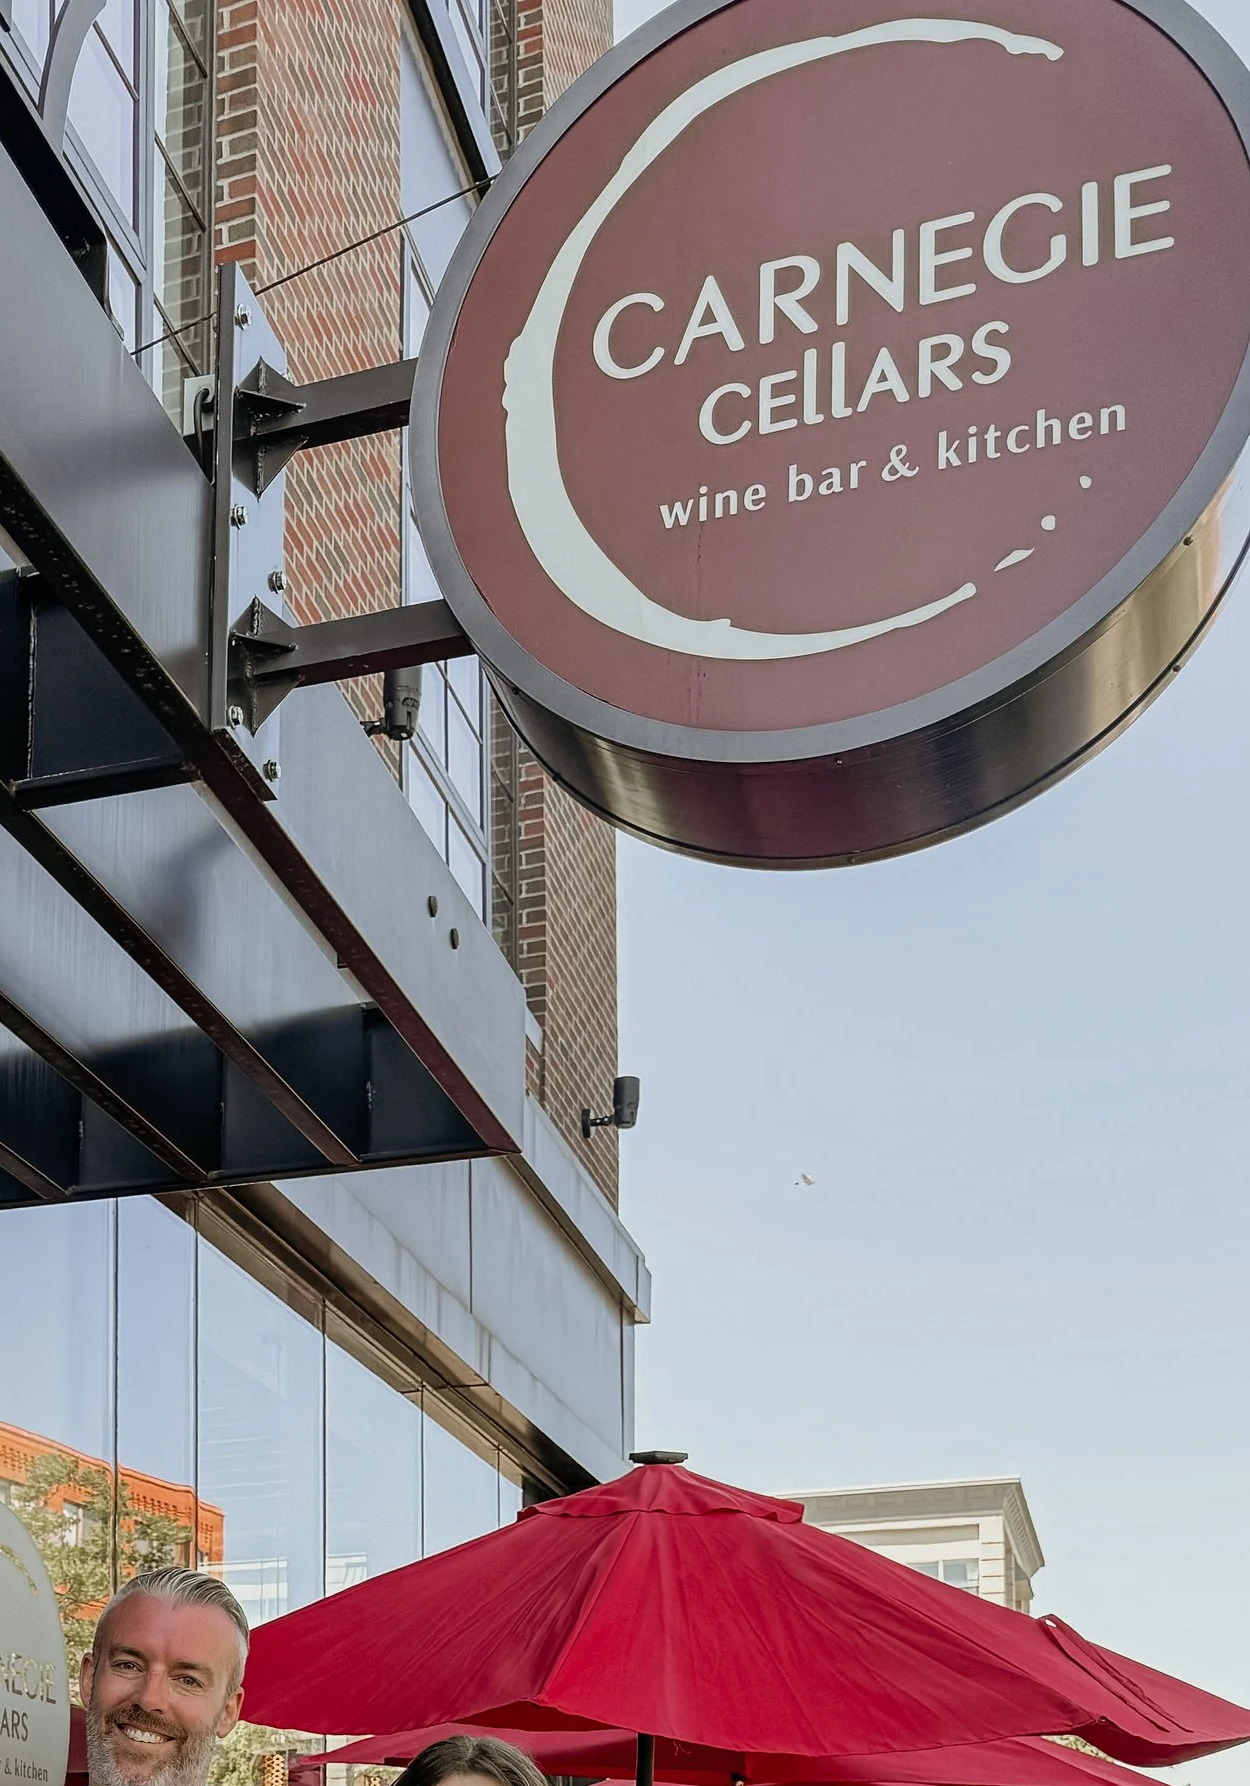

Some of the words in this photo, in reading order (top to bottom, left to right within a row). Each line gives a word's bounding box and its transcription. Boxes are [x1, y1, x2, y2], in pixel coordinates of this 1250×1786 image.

[592, 164, 1175, 380] CARNEGIE
[659, 485, 766, 529] wine
[788, 459, 867, 503] bar
[881, 444, 920, 482] &
[937, 402, 1126, 470] kitchen
[4, 1758, 13, 1776] &
[14, 1757, 49, 1782] kitchen
